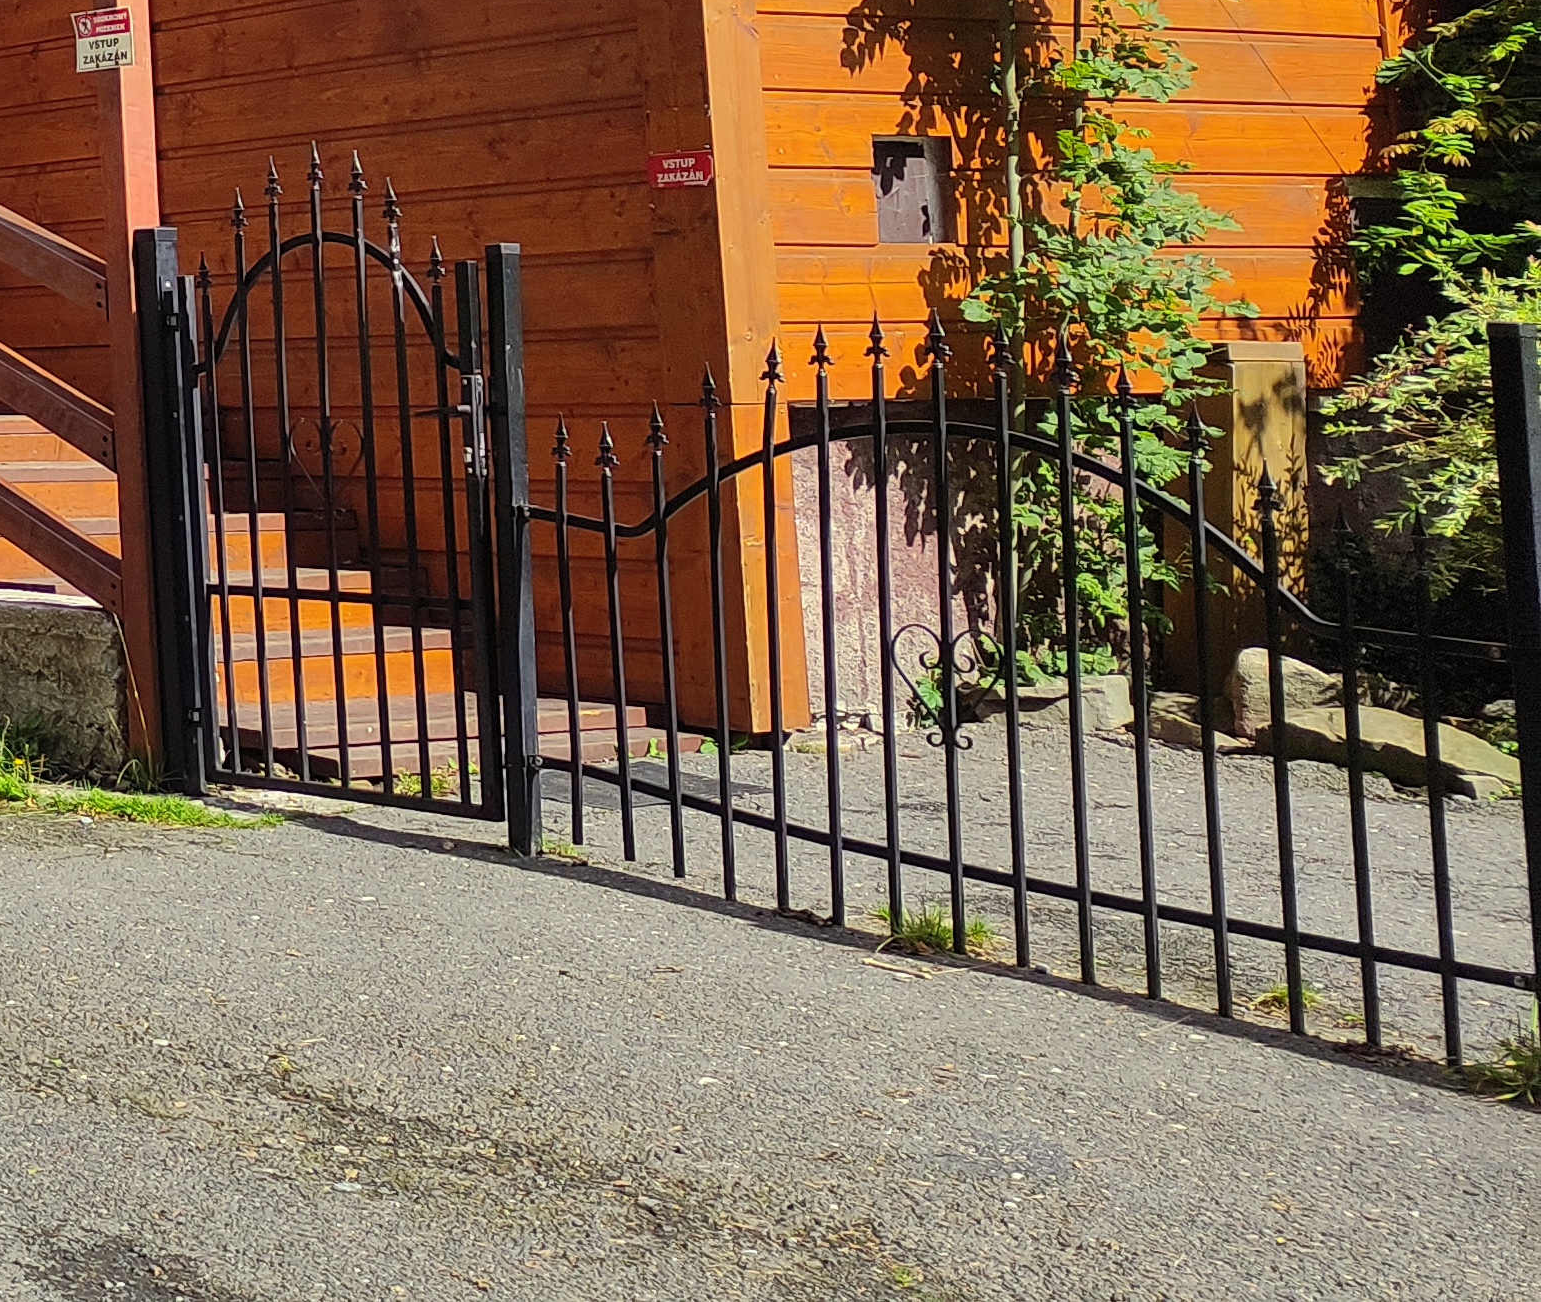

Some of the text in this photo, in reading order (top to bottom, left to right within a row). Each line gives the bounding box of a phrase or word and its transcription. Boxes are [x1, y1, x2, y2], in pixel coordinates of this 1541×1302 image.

[88, 37, 120, 51] VSTUP
[82, 49, 128, 65] ZAKÁZÁN
[661, 157, 696, 170] VSTUP
[656, 168, 704, 183] ZAKÁZÁN
